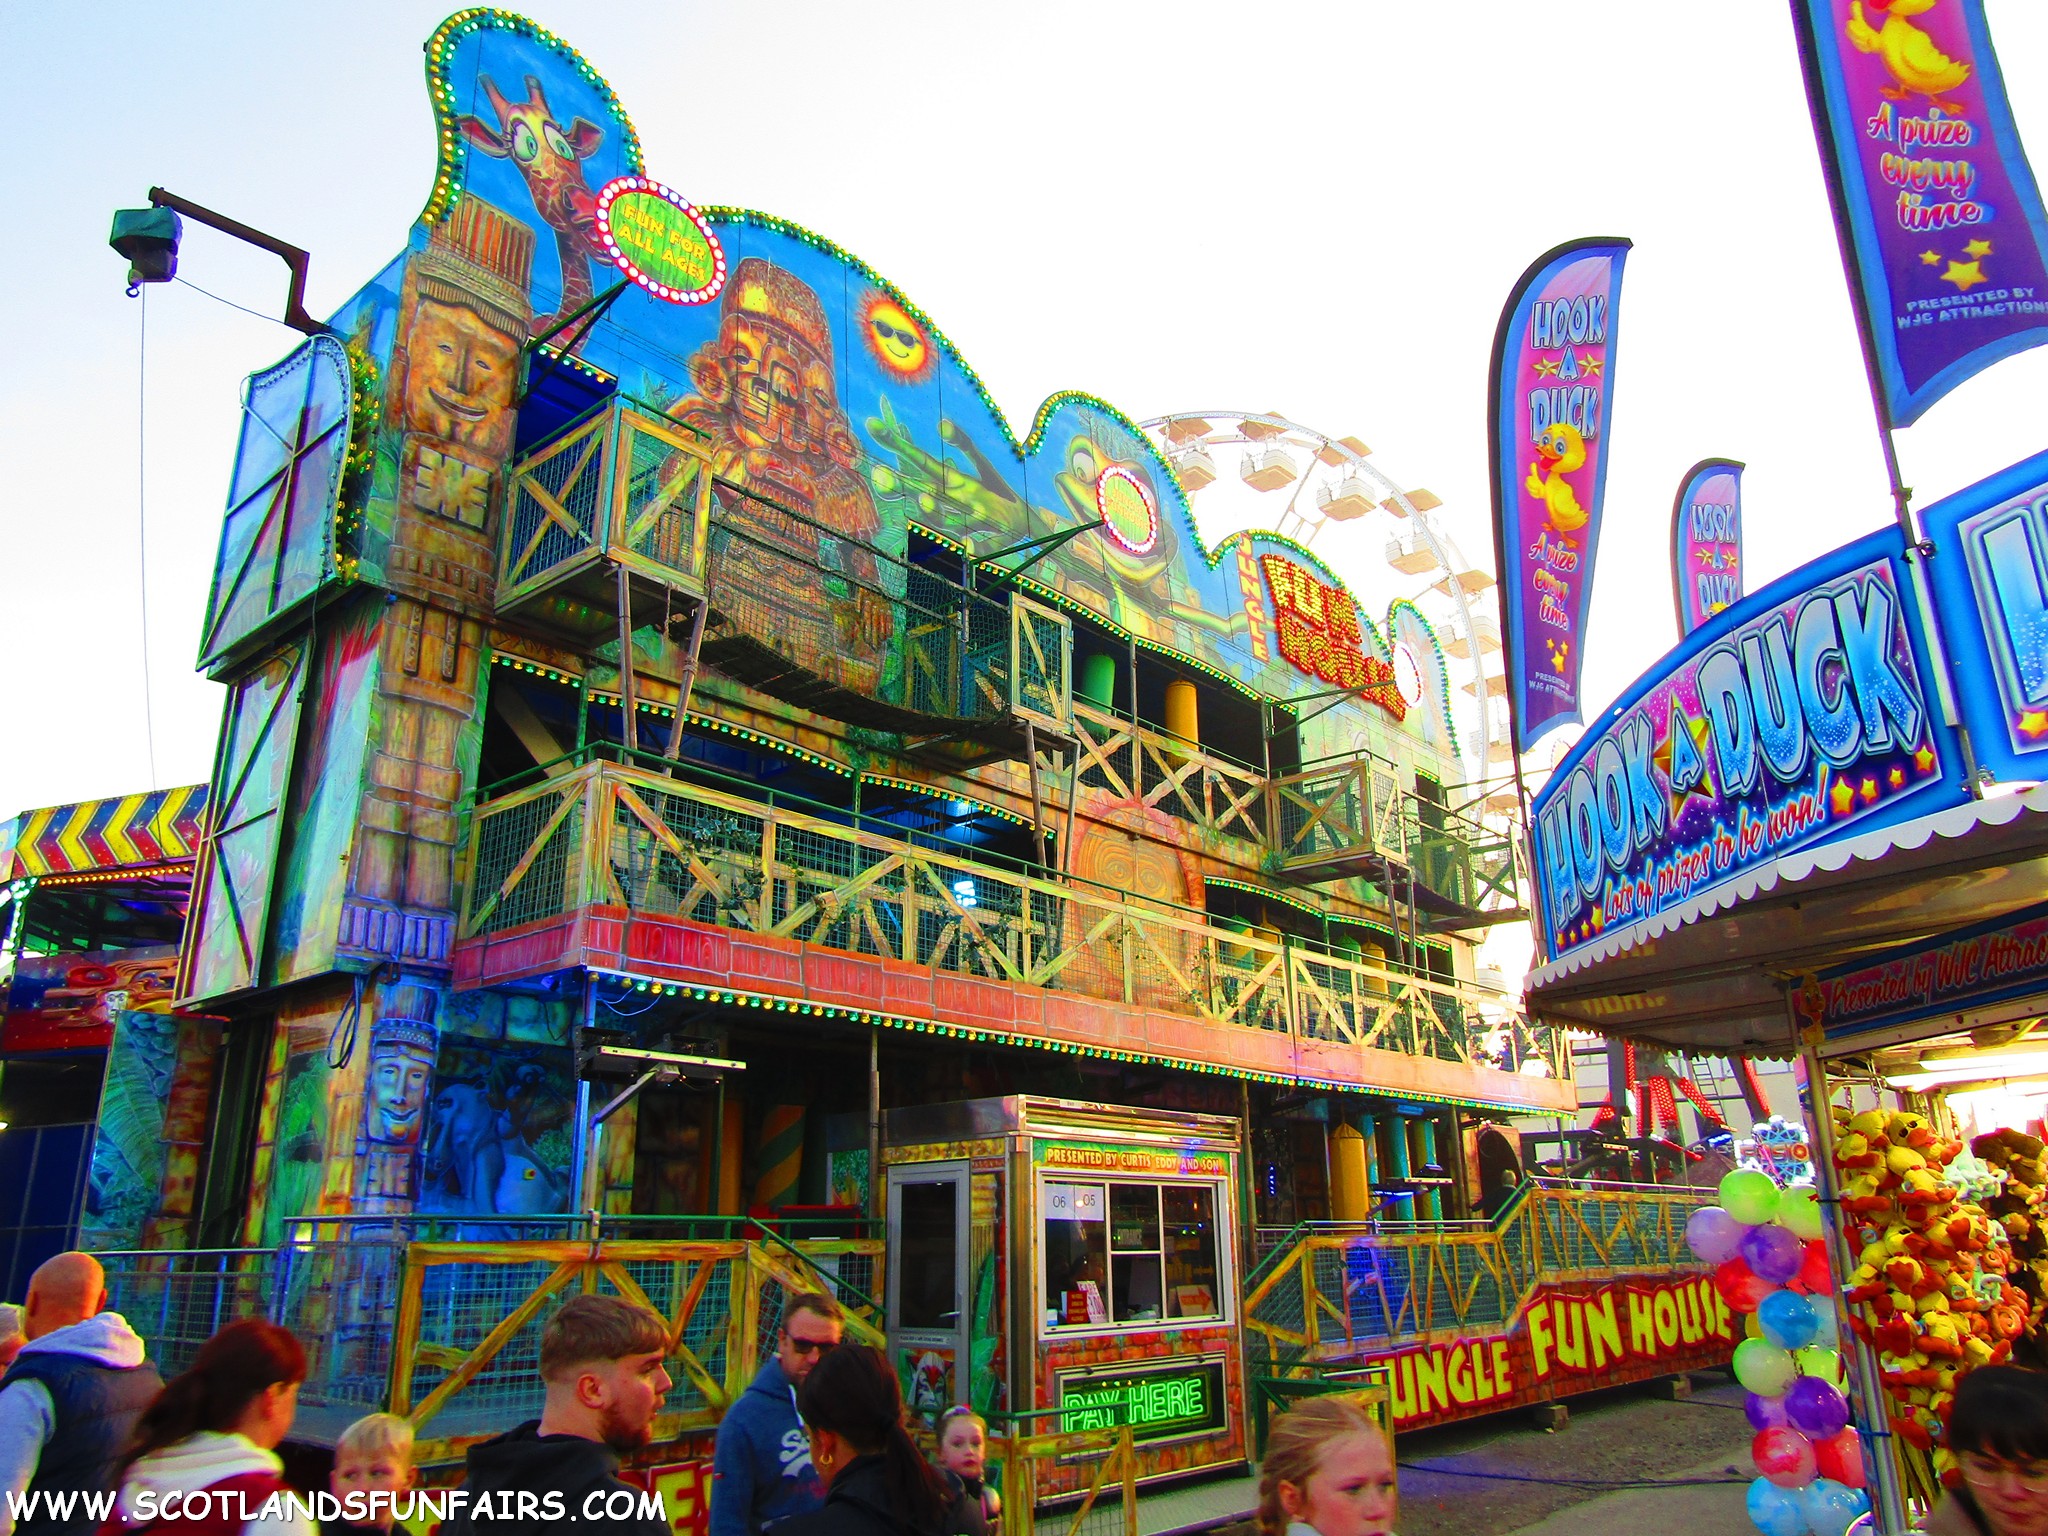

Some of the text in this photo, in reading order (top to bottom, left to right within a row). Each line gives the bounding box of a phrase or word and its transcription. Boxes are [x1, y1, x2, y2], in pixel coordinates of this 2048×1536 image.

[1867, 101, 1970, 154] A prize
[1881, 152, 1974, 199] every
[624, 203, 705, 262] FUN FOR
[1897, 190, 1982, 231] time
[618, 224, 705, 282] ALL AGES
[1531, 294, 1605, 349] HOOK
[1897, 313, 1934, 329] WJC
[1906, 286, 2034, 312] PRESENTED BY
[1556, 346, 1580, 382] A
[1528, 385, 1599, 444] DUCK
[1529, 532, 1547, 560] A
[1691, 503, 1737, 543] HOOK
[1711, 541, 1724, 570] A
[1236, 533, 1270, 663] JUNGLE
[1260, 554, 1362, 644] FUN
[1696, 573, 1738, 617] DUCK
[1541, 708, 1665, 930] HOOK
[1670, 706, 1704, 794] A
[1695, 568, 1923, 797] DUCK
[1603, 764, 1828, 926] Lots of prizes to be won!
[1830, 964, 1909, 1017] Presented
[1912, 957, 1935, 1006] by
[1937, 940, 1980, 992] WJC
[1047, 1147, 1102, 1166] PRESENTED
[1105, 1152, 1117, 1167] BY
[1121, 1153, 1151, 1168] CURTIS
[1155, 1156, 1177, 1170] EDDY
[1180, 1157, 1198, 1171] AND
[1052, 1193, 1096, 1208] 06 05
[1527, 1288, 1625, 1379] FUN
[1628, 1277, 1734, 1358] HOUSE
[1065, 1377, 1204, 1433] PAY HERE
